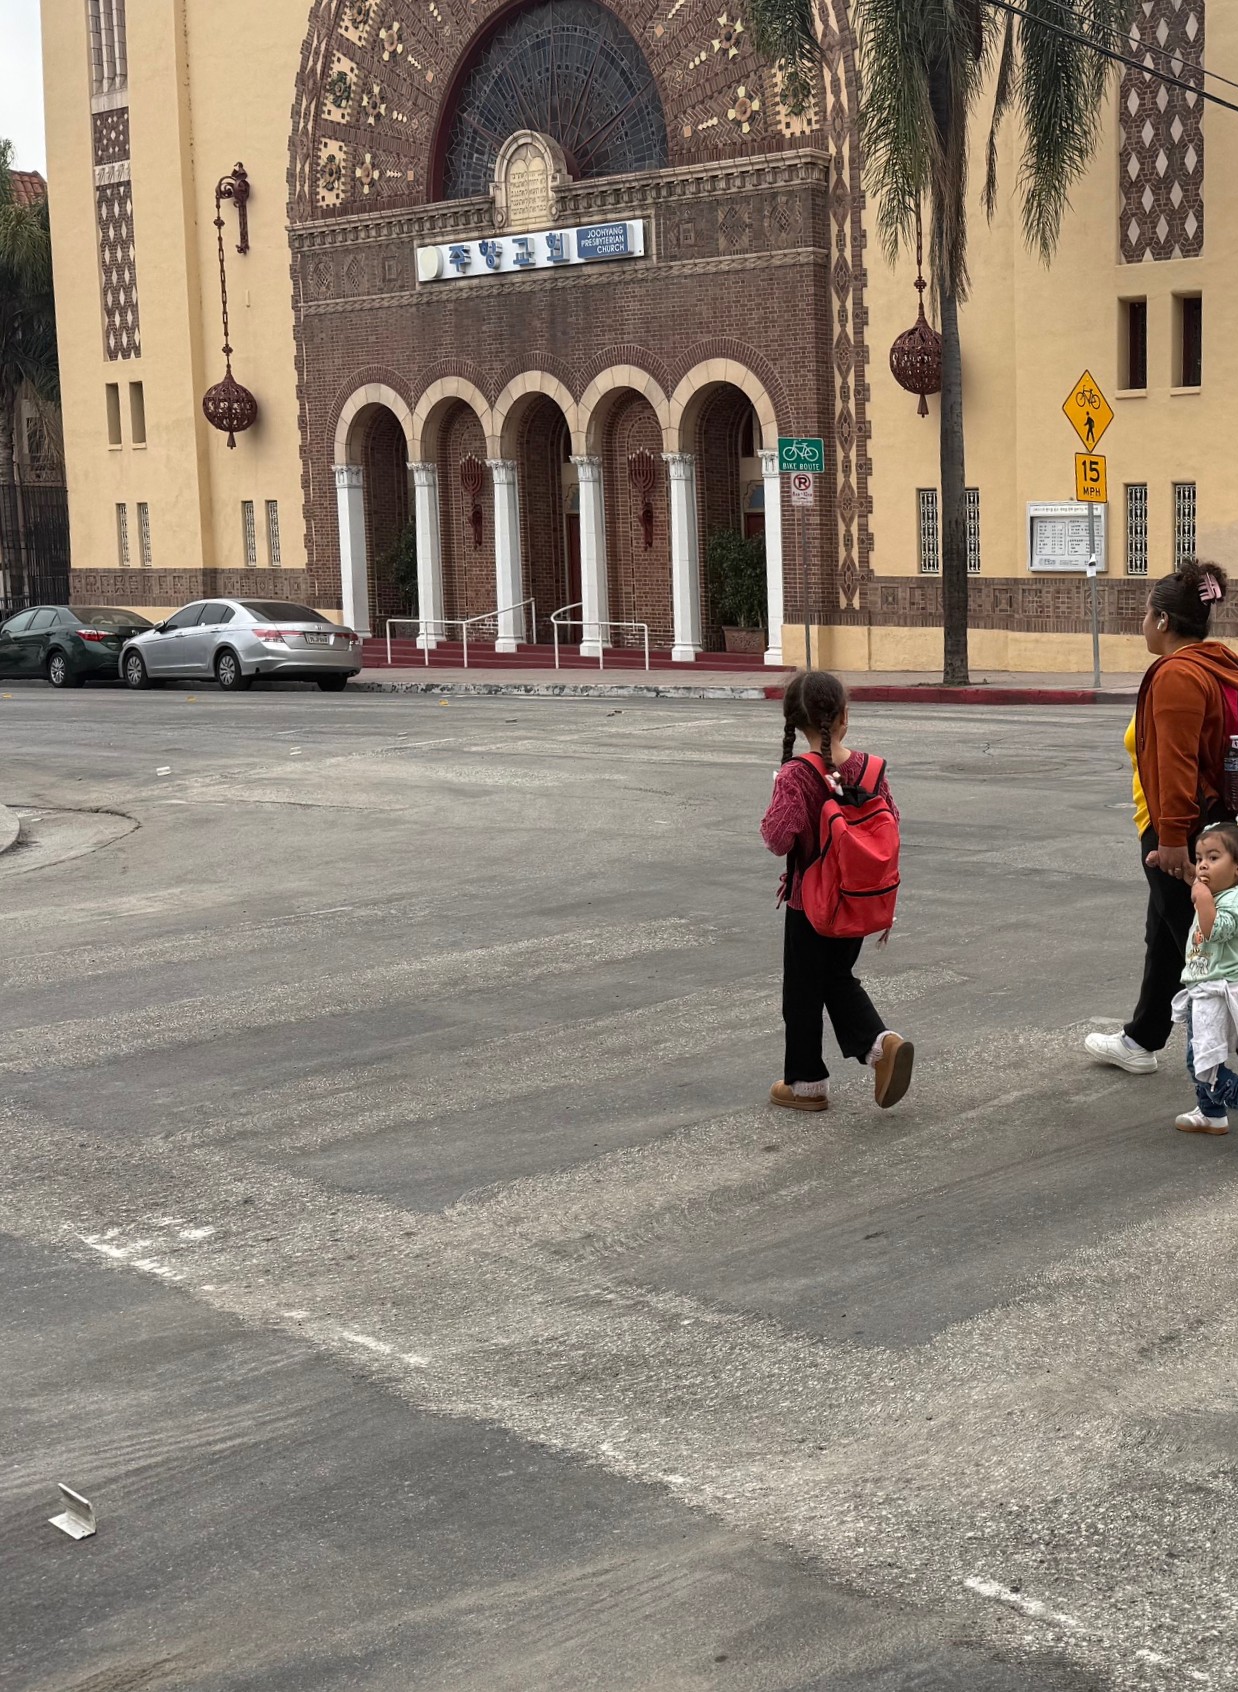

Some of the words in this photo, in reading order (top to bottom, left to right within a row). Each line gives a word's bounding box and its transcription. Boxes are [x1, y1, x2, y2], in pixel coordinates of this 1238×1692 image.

[587, 226, 623, 239] JOOHYANG
[580, 235, 624, 248] PRESBYTERIAN
[596, 243, 625, 254] CHURCH
[782, 462, 797, 470] BIKE
[800, 463, 820, 471] ROUTE
[1081, 459, 1100, 483] 15
[1083, 486, 1101, 497] MPH
